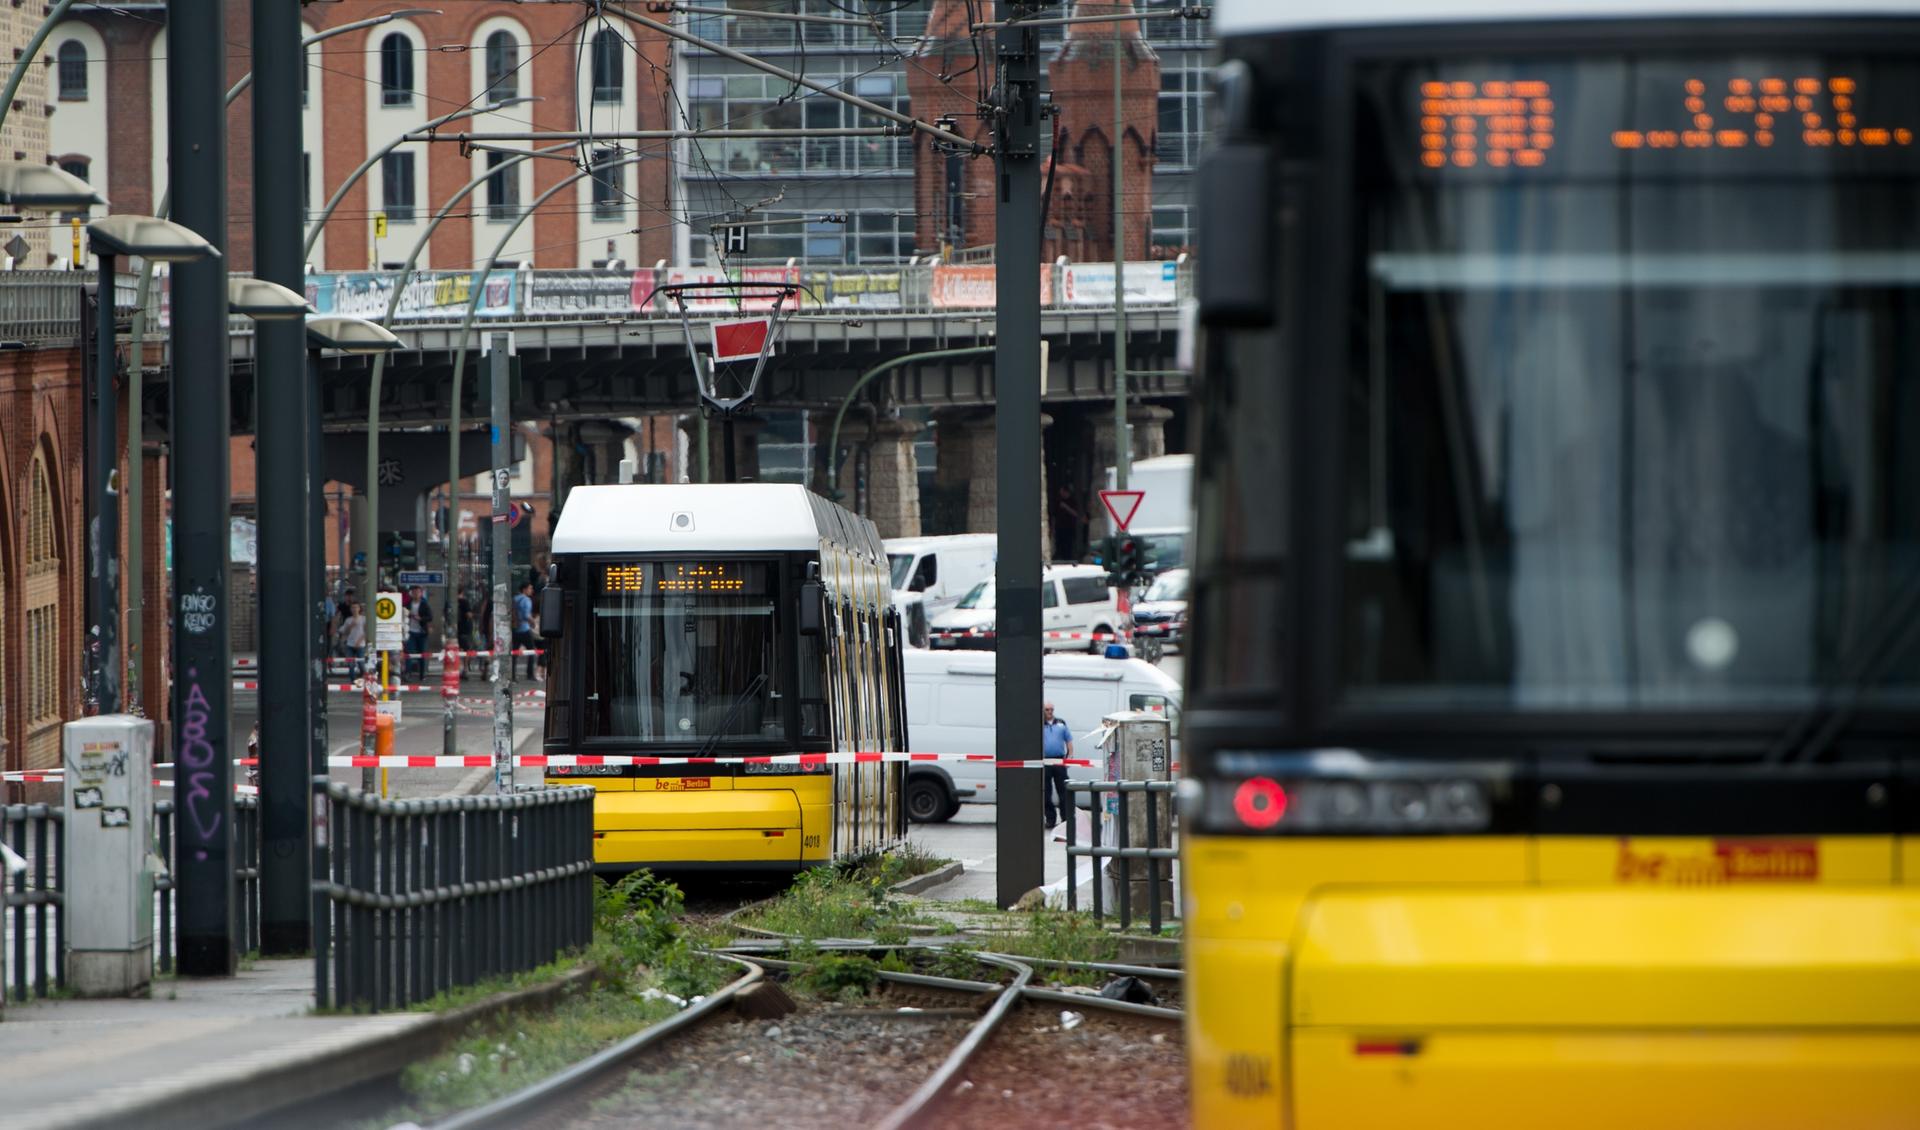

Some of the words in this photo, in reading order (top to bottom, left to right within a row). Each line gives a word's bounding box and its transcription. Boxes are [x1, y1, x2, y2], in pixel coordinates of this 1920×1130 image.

[376, 216, 386, 235] F
[728, 226, 745, 251] H
[606, 566, 643, 591] M10
[379, 602, 391, 614] H
[655, 778, 670, 790] be
[685, 779, 709, 788] Berlin
[804, 835, 820, 848] 4018
